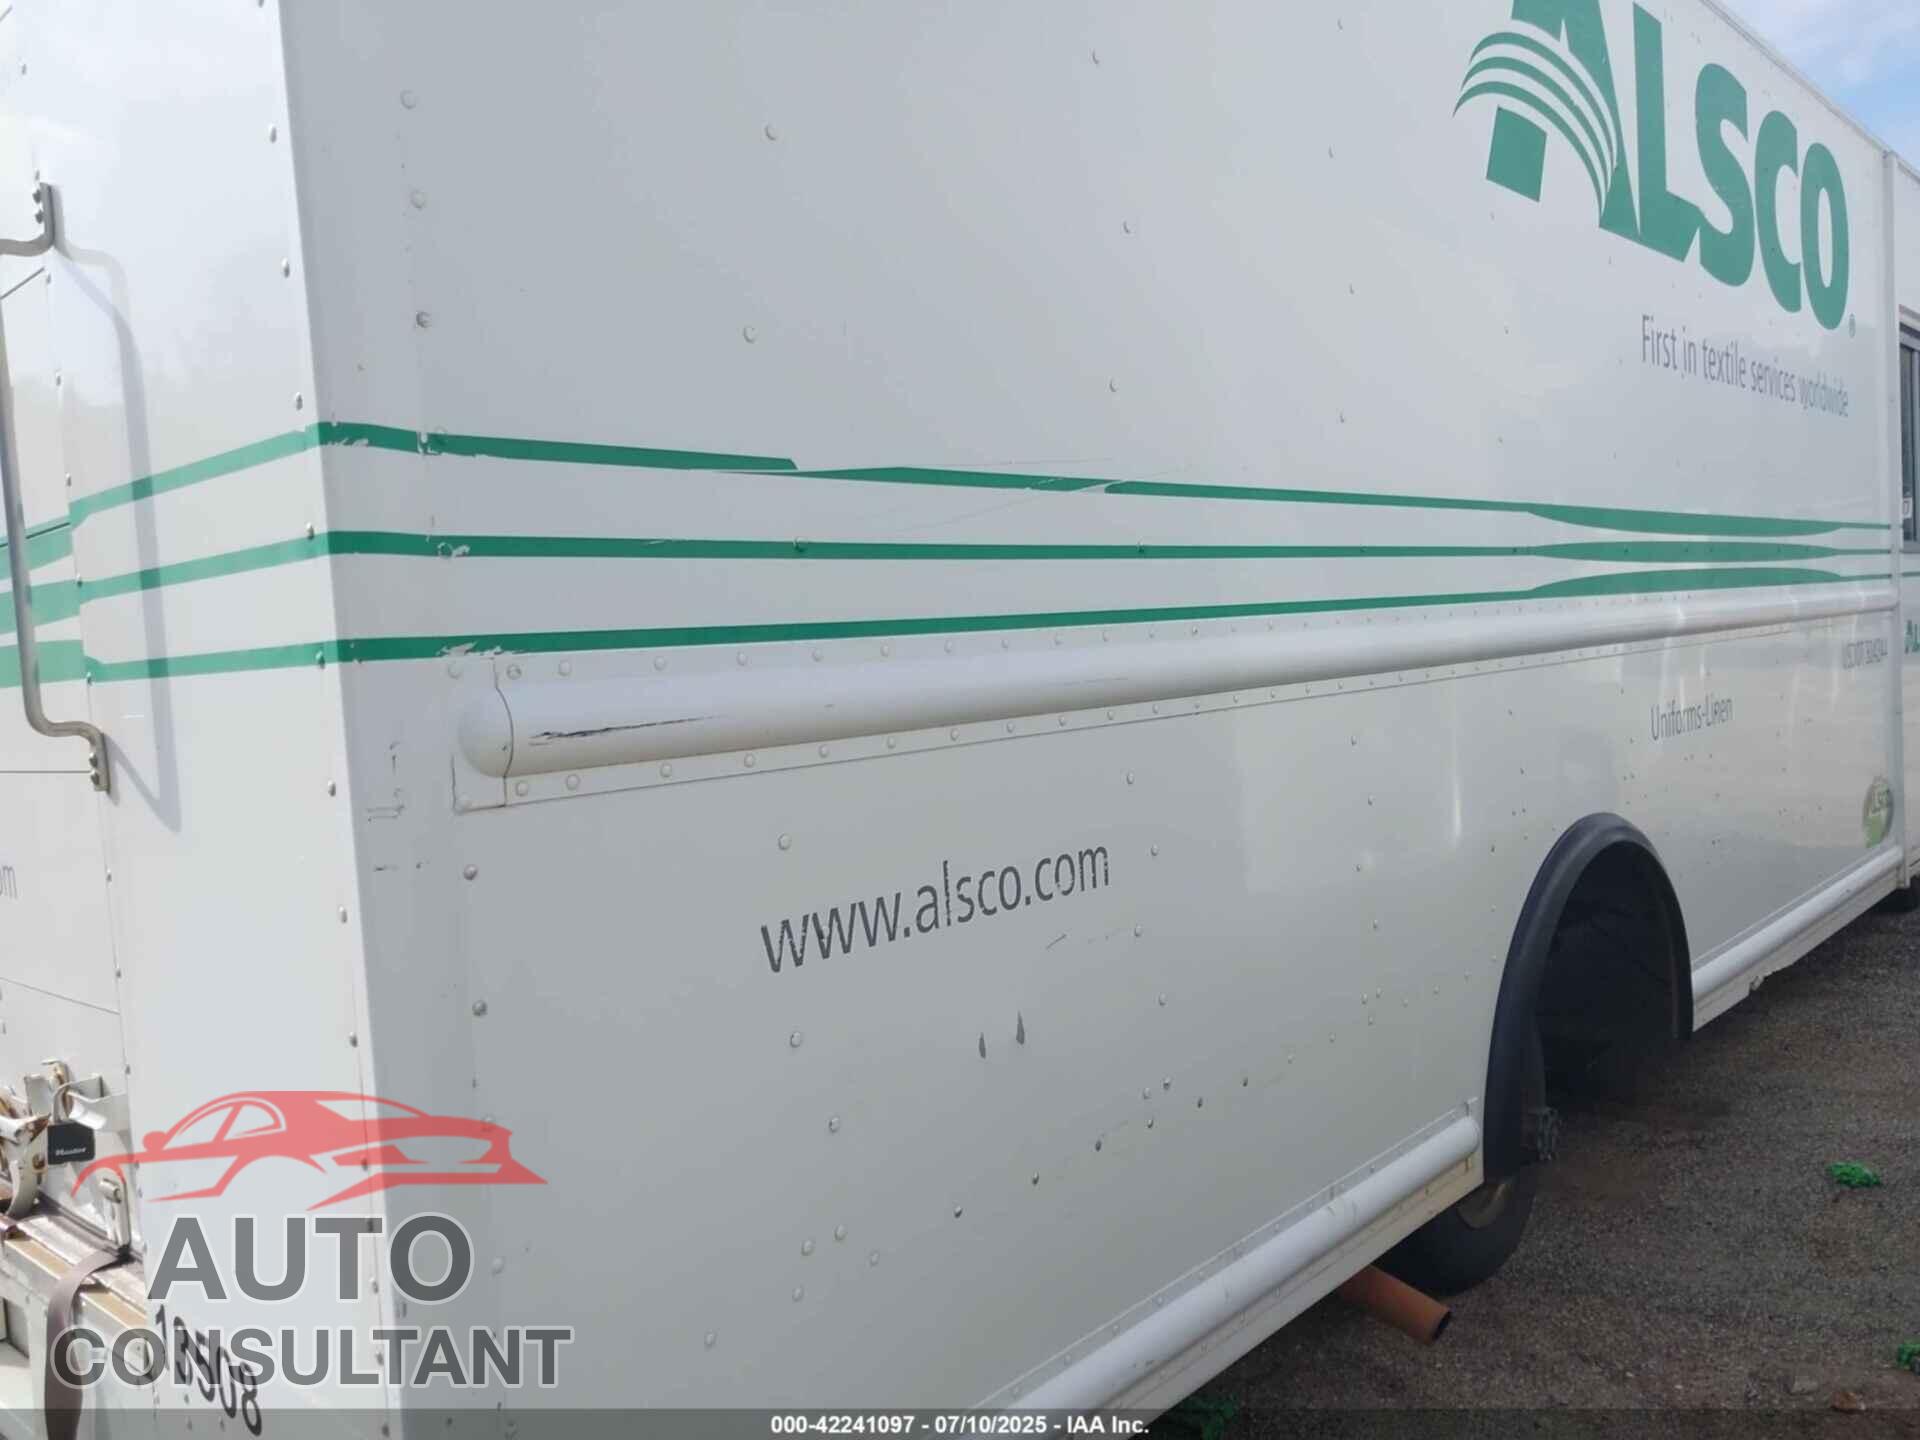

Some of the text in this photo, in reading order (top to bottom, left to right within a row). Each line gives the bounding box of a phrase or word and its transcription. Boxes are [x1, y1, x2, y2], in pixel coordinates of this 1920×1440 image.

[1452, 0, 1850, 330] ALSCO
[1641, 314, 1849, 418] First in textile services worldwide
[760, 844, 1110, 974] www.alsco.com
